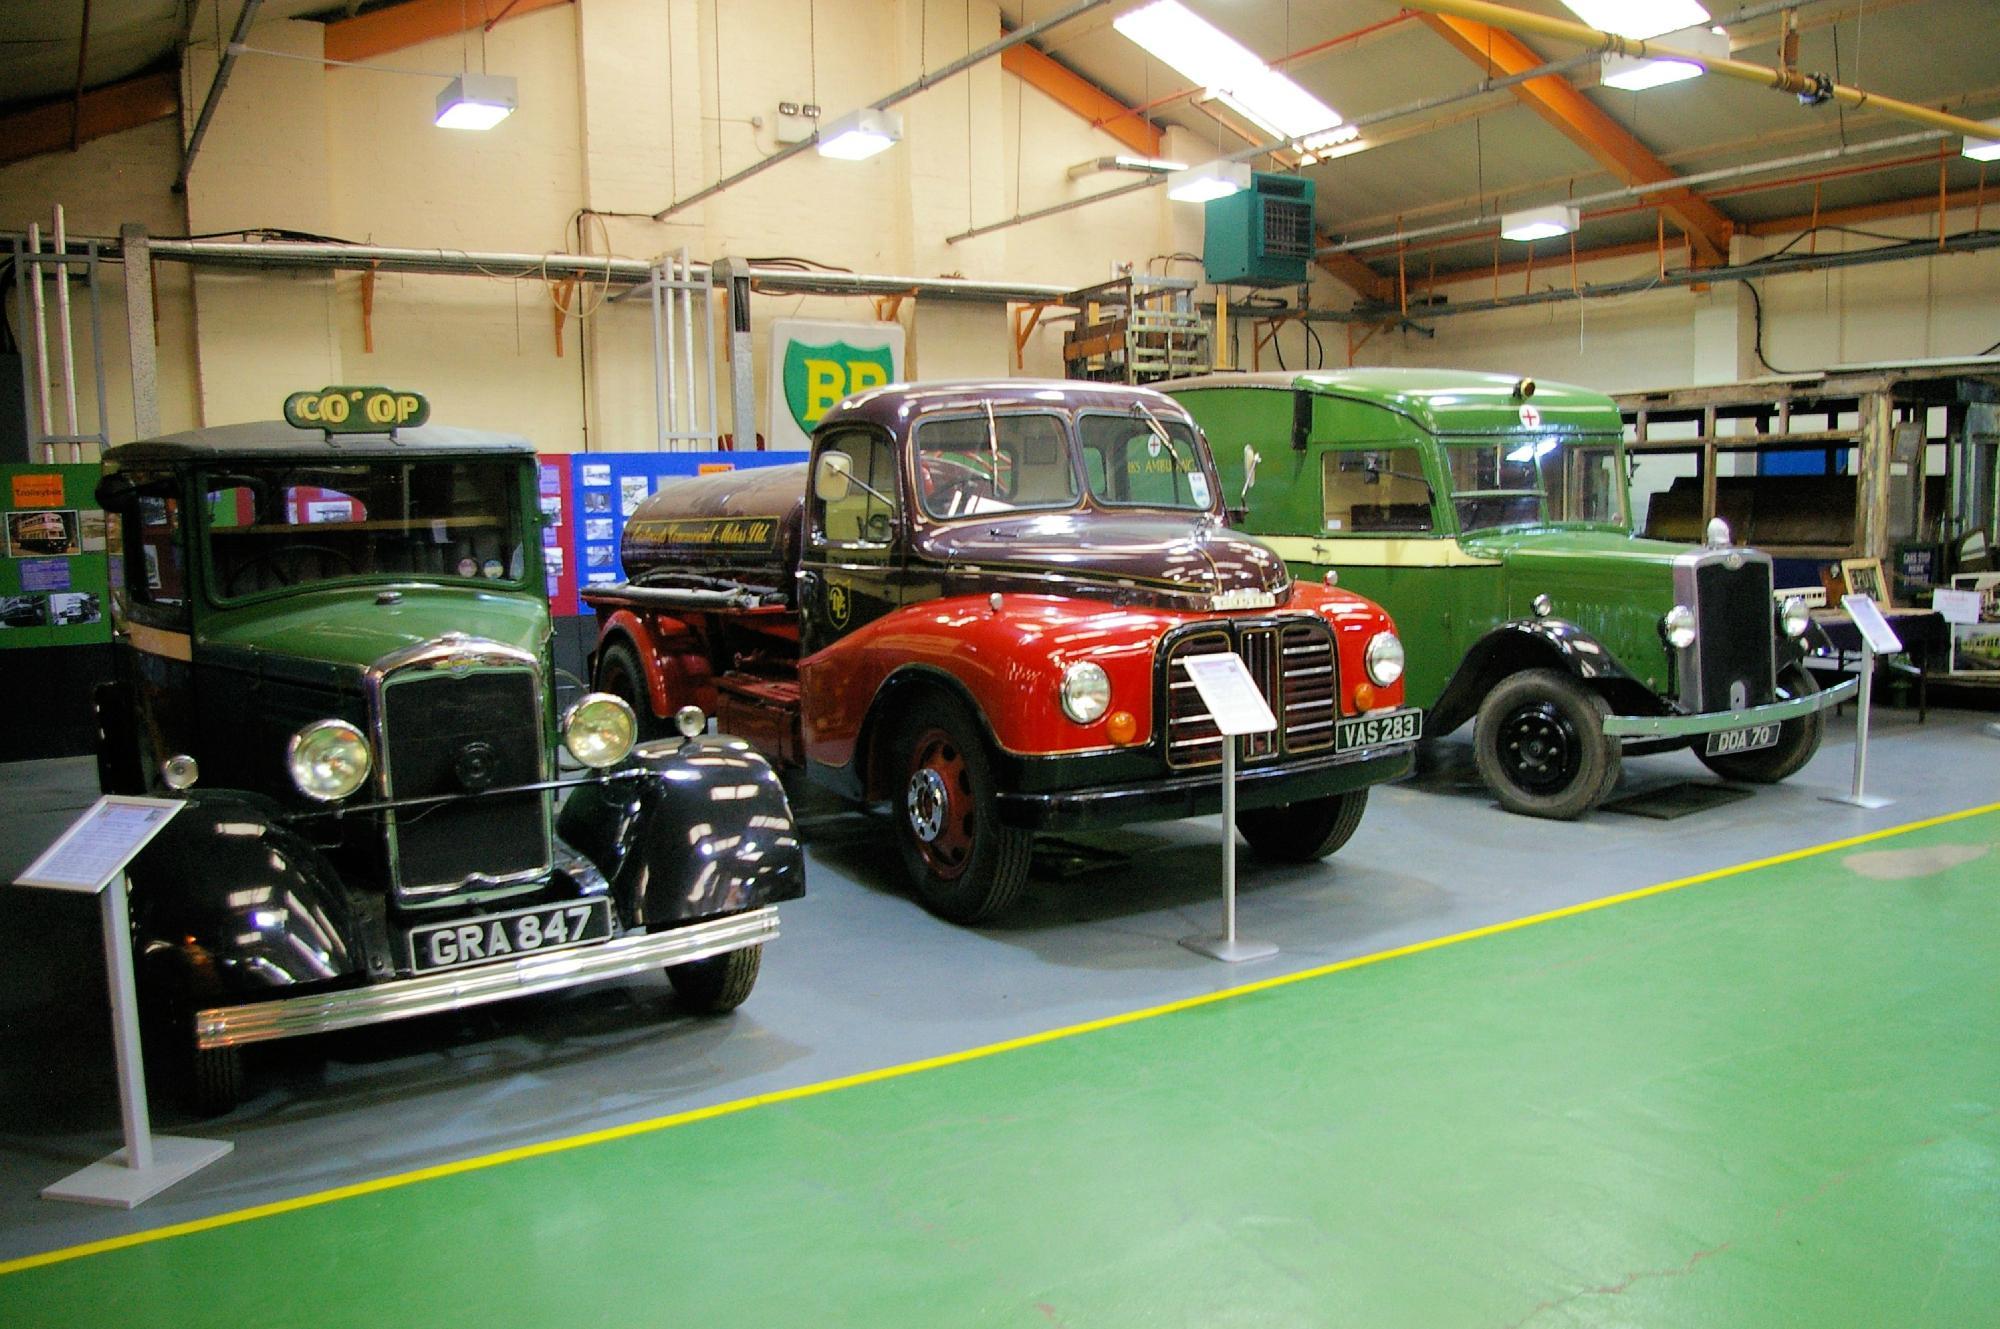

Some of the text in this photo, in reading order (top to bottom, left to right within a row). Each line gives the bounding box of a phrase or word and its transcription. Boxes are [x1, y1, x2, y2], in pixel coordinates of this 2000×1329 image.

[803, 359, 887, 421] BP
[1345, 715, 1413, 747] VAS 283
[1718, 725, 1770, 752] DDA 70
[431, 906, 592, 964] GRA 847
